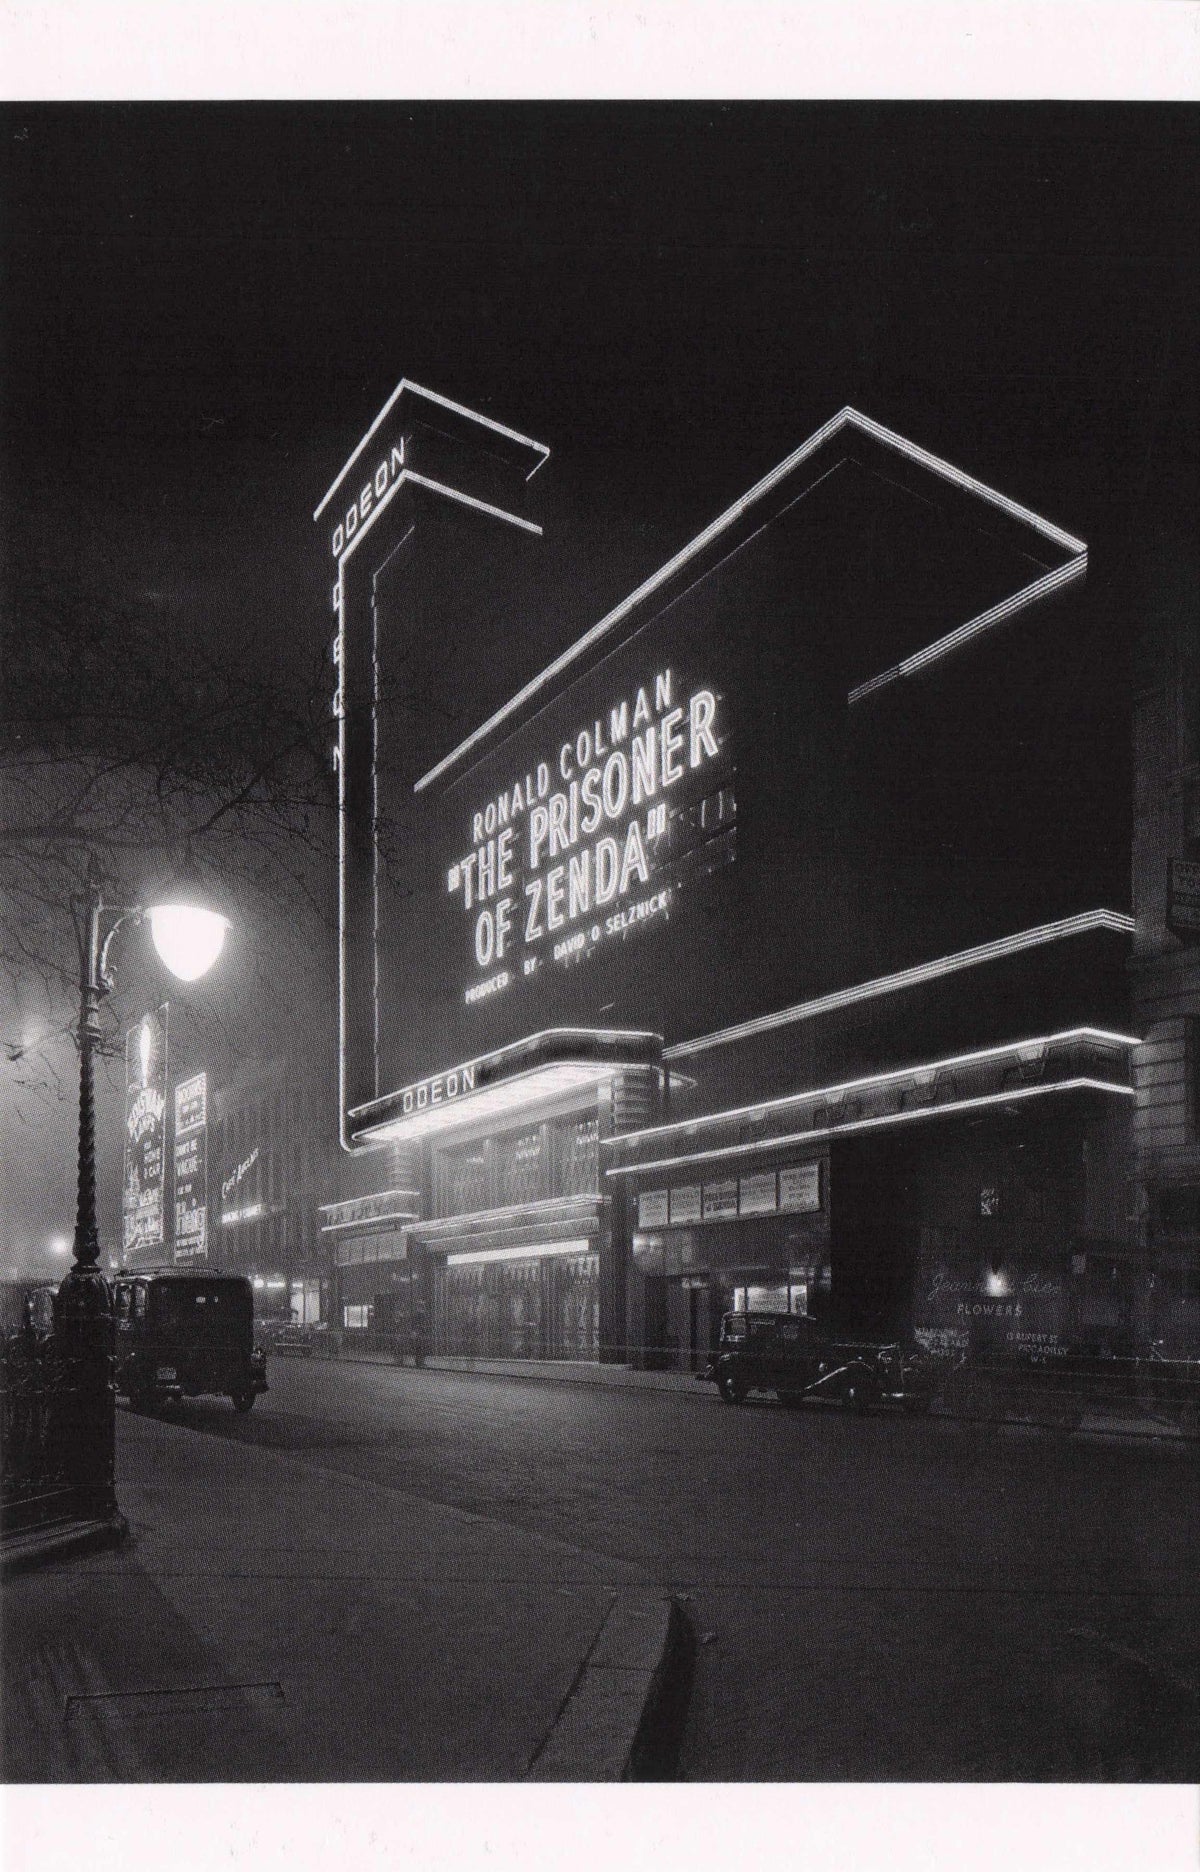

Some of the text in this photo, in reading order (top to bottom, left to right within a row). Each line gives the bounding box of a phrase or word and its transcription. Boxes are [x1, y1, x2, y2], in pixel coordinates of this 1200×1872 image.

[332, 436, 404, 557] ODEON
[473, 669, 671, 843] RONALD COLMAN
[530, 691, 718, 868] PRISONER
[465, 972, 509, 1004] PRODUCED
[524, 957, 537, 975] BY
[554, 933, 585, 960] DAVID
[605, 890, 668, 935] SELZNICK
[475, 898, 511, 966] OF
[403, 1066, 477, 1113] ODEON
[957, 1303, 1023, 1317] FLOWERS
[1017, 1343, 1069, 1355] PICCADILLY
